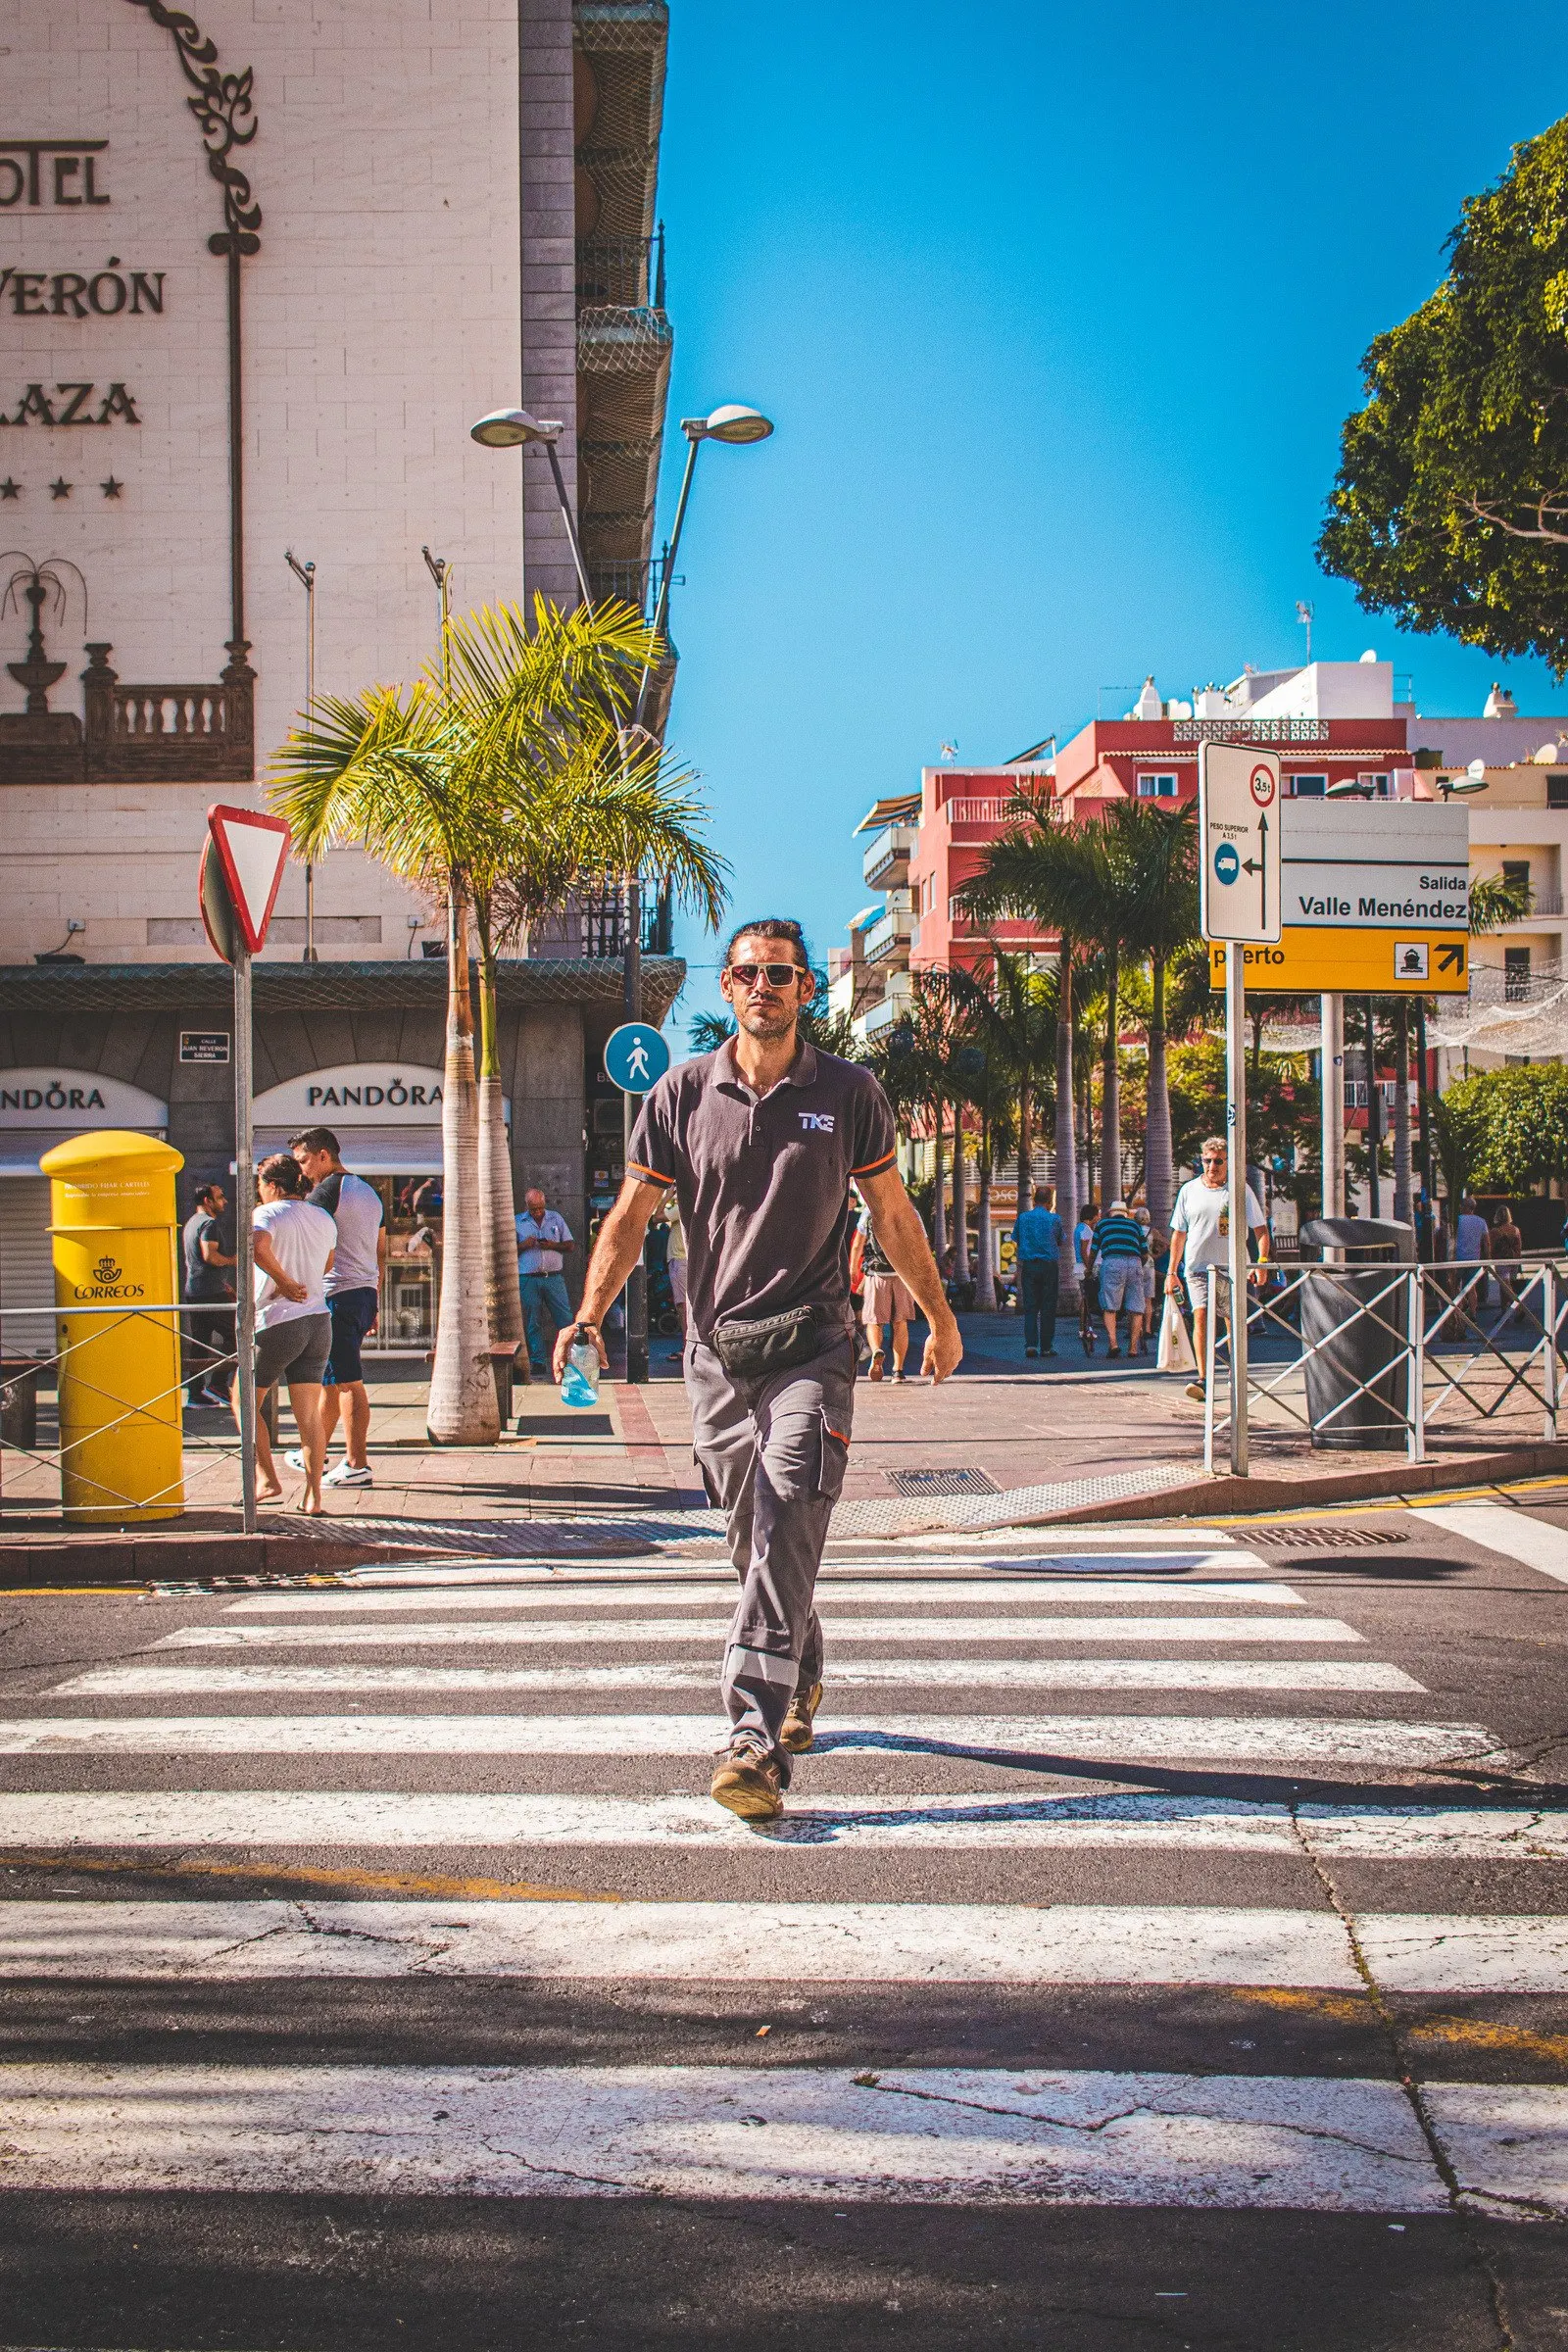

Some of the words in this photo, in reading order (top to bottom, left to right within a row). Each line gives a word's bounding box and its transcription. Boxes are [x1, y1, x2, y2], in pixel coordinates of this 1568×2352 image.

[0, 383, 142, 425] AZA
[1224, 824, 1250, 834] SUPERIOR
[1419, 876, 1466, 891] Salida
[1298, 896, 1351, 915] Valle
[1358, 898, 1467, 919] Menéndez
[1214, 946, 1285, 967] perto
[308, 1080, 444, 1106] PANDORA
[74, 1284, 145, 1299] CORREOS
